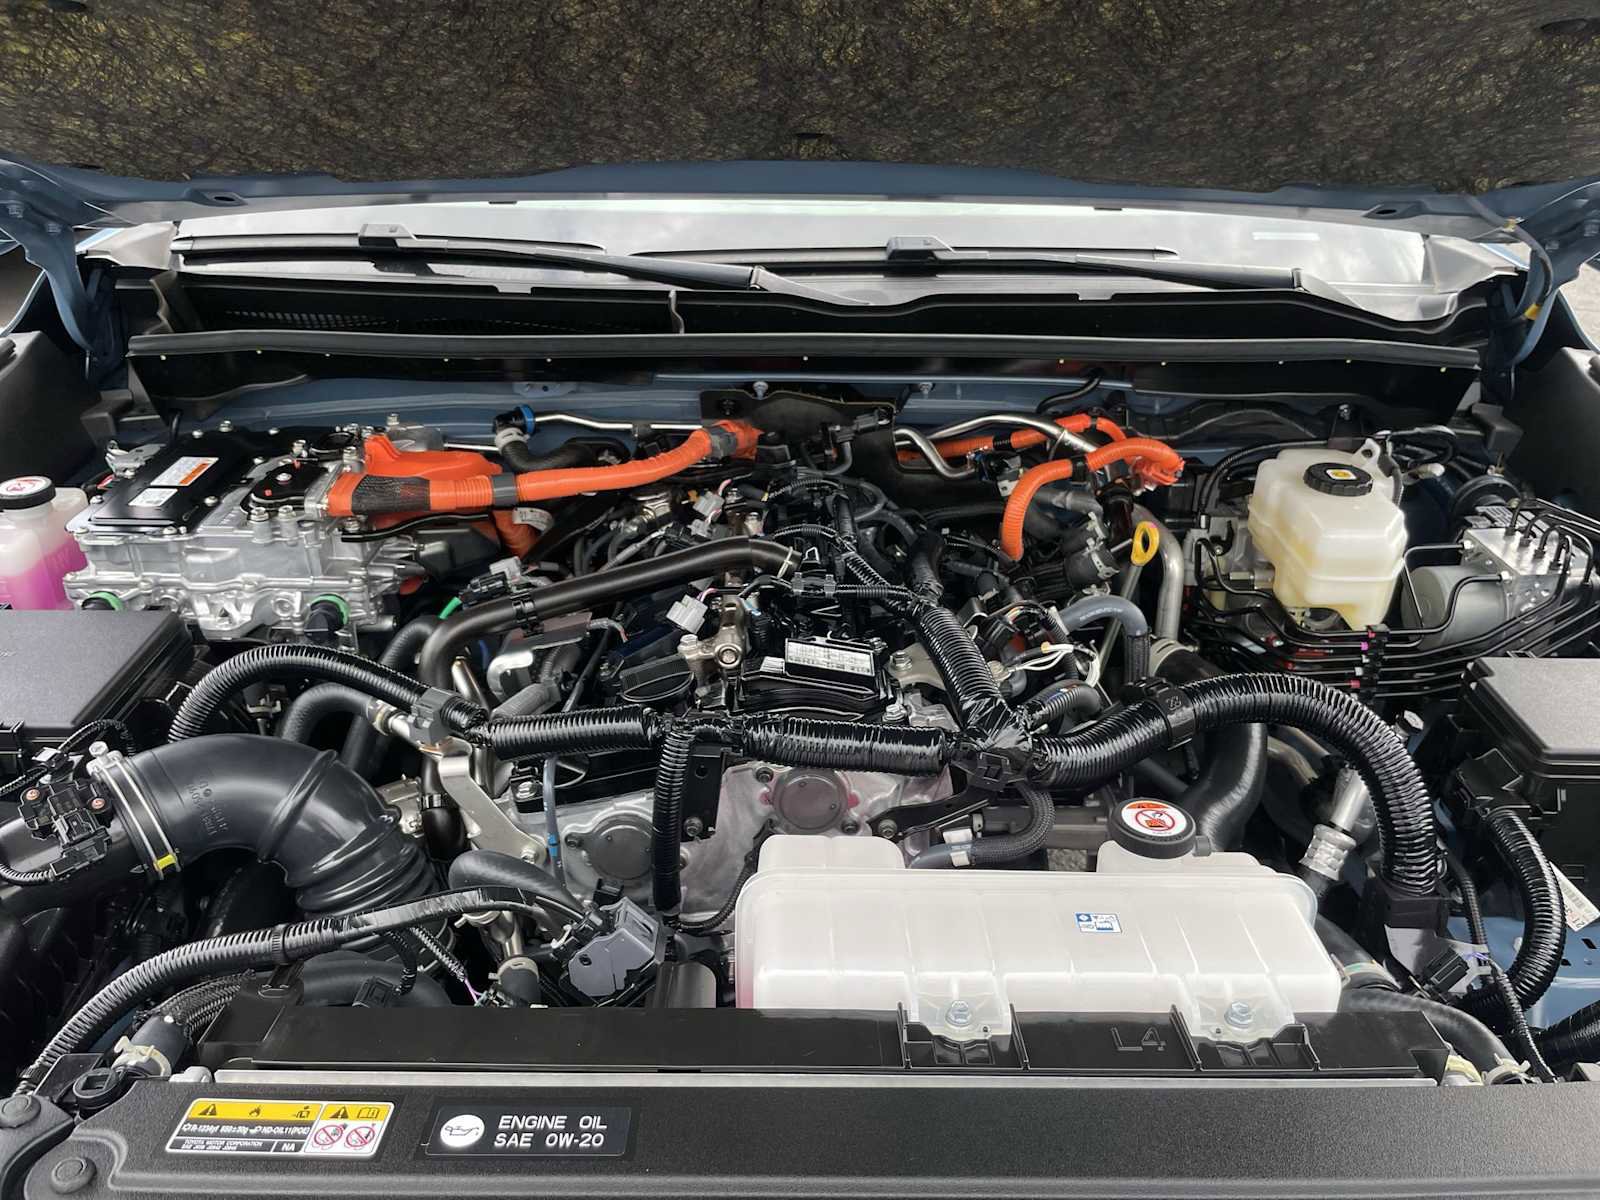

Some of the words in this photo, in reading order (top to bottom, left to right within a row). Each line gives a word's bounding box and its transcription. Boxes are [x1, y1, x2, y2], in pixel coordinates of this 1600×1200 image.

[1110, 1027, 1167, 1052] L4
[498, 1115, 568, 1129] ENGINE
[579, 1115, 608, 1129] OIL
[493, 1132, 534, 1147] SAE
[545, 1132, 605, 1147] 0W-20
[281, 1142, 296, 1152] NA
